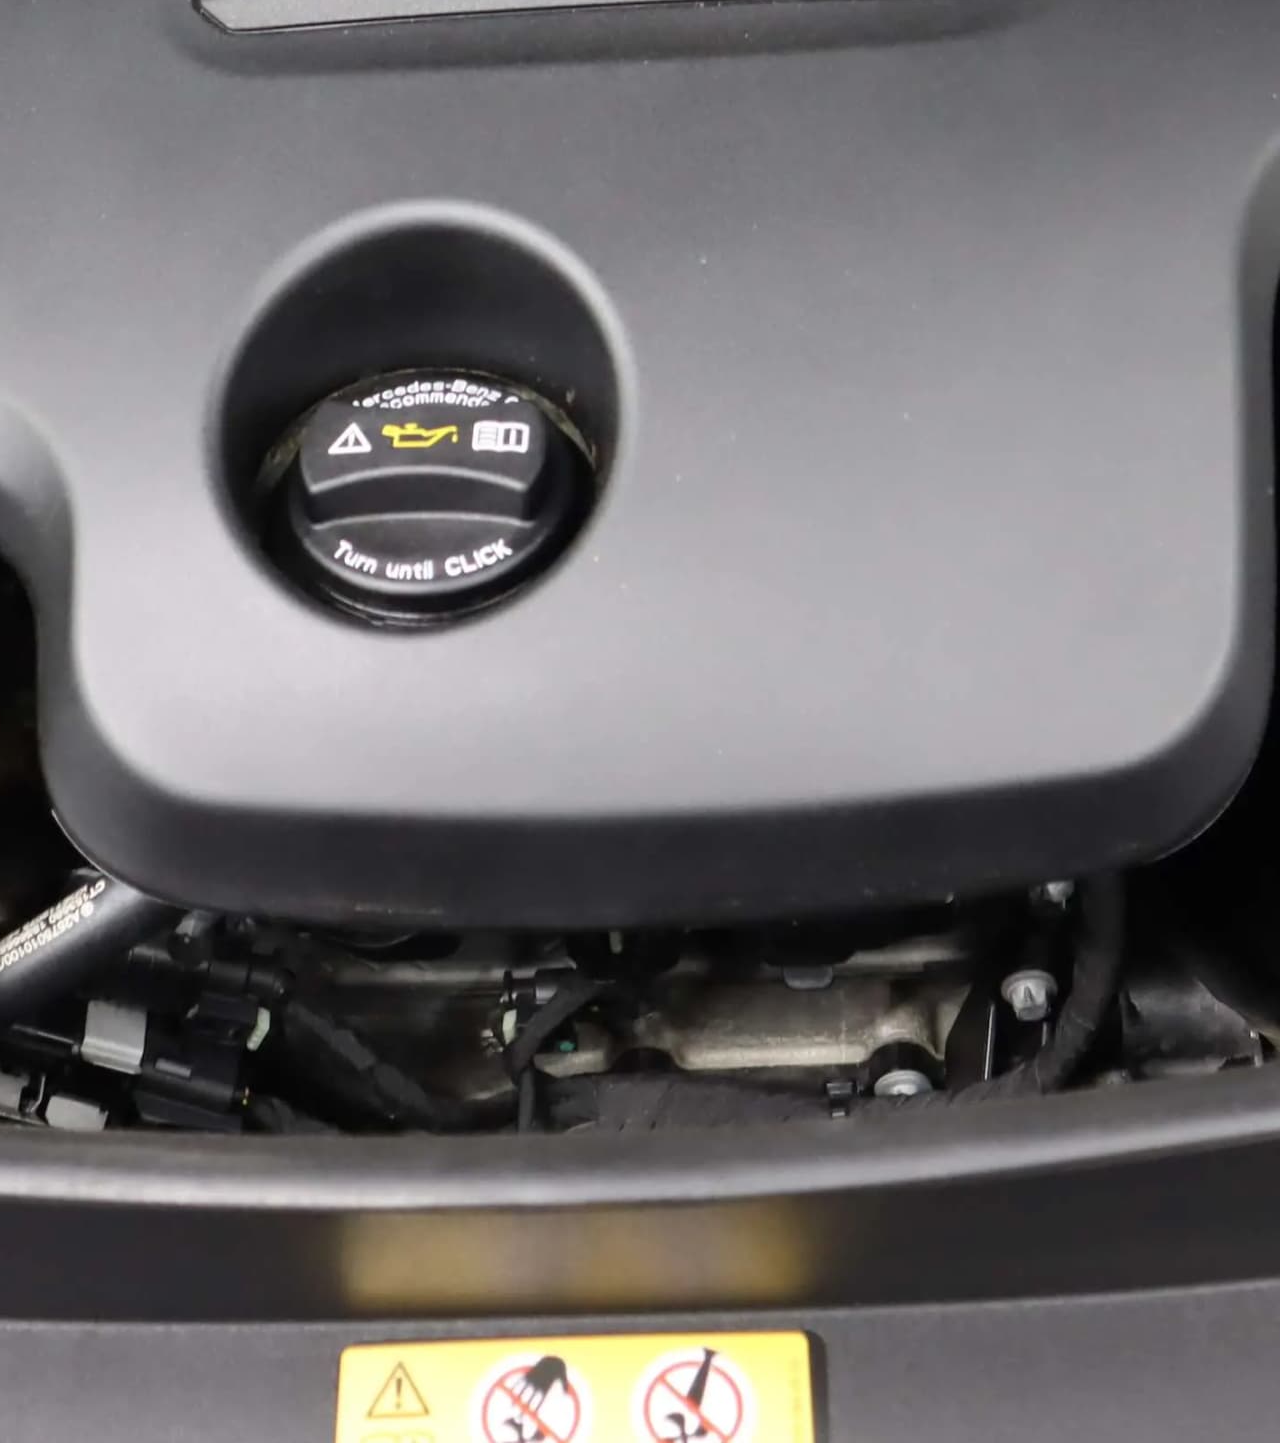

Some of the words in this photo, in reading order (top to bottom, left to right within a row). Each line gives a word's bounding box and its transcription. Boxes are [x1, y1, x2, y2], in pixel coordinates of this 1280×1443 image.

[352, 379, 502, 408] ercedes-Benz
[334, 539, 378, 575] Turn
[384, 559, 434, 581] until
[444, 538, 513, 577] CLICK
